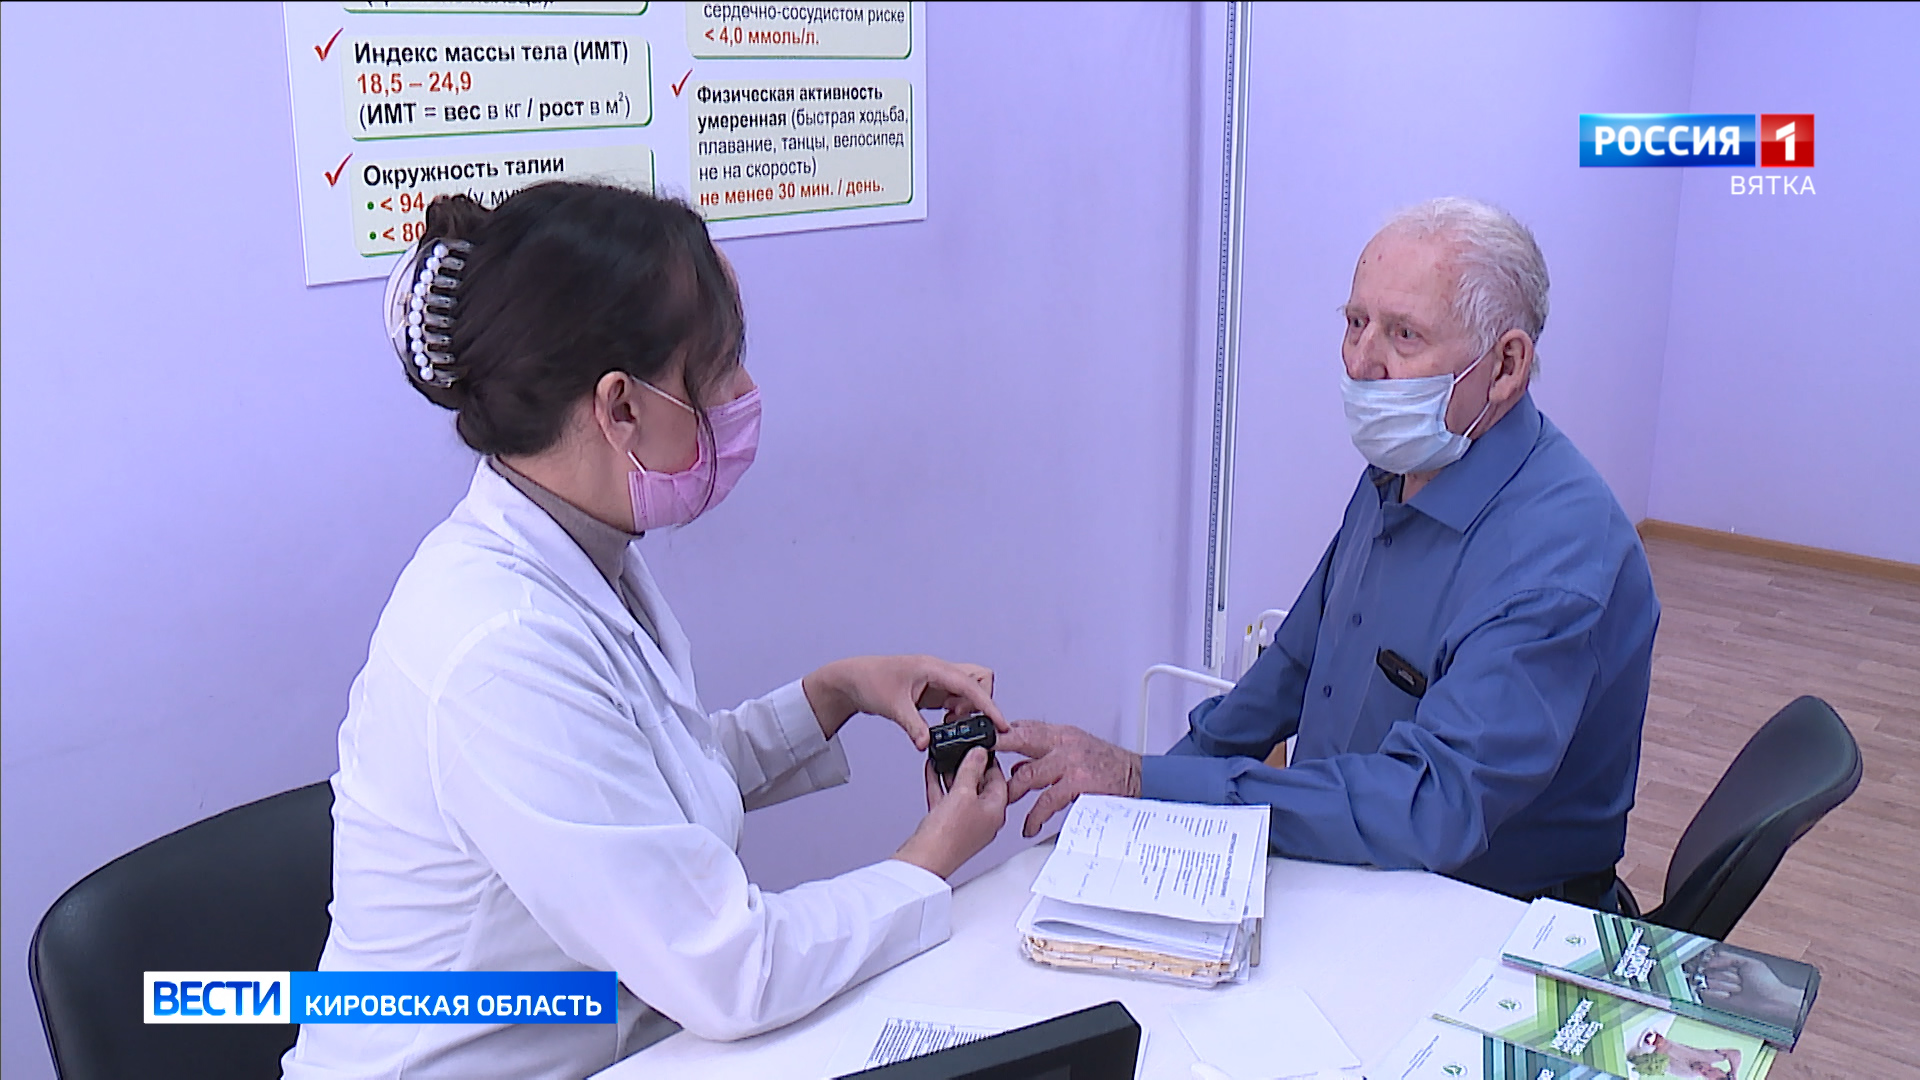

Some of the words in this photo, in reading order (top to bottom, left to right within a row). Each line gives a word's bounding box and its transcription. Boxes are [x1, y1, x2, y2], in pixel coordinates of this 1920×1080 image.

[704, 4, 864, 24] сердечно-сосудистом
[868, 7, 905, 25] риске
[705, 29, 714, 41] <
[719, 27, 742, 46] 4,0
[748, 28, 819, 45] ммоль/л.
[355, 42, 438, 66] Индекс
[445, 45, 514, 62] массы
[522, 44, 567, 61] тела
[574, 41, 628, 65] (ИМТ)
[358, 72, 402, 98] 18,5
[429, 71, 472, 95] 24,9
[697, 86, 795, 103] Физическая
[799, 87, 883, 101] активность
[360, 104, 416, 129] (ИМТ
[425, 107, 437, 118] =
[444, 104, 480, 121] вес
[488, 105, 498, 119] в
[505, 102, 522, 118] кг
[527, 98, 533, 118] /
[539, 98, 584, 121] рост
[590, 99, 600, 114] в
[697, 113, 786, 133] умеренная
[791, 108, 855, 130] (быстрая
[859, 106, 908, 125] ходьба,
[699, 138, 777, 155] плавание,
[782, 135, 829, 151] танцы,
[834, 132, 904, 148] велосипед
[364, 165, 498, 189] Окружность
[505, 157, 565, 175] талии
[699, 167, 718, 181] не
[723, 165, 741, 178] на
[746, 157, 817, 179] скорость)
[381, 199, 392, 211] <
[400, 191, 424, 212] 94
[700, 191, 719, 205] не
[725, 188, 773, 204] менее
[778, 183, 795, 200] 30
[800, 182, 833, 198] мин.
[837, 179, 842, 195] /
[846, 180, 884, 197] день.
[382, 230, 395, 241] <
[403, 222, 425, 242] 80
